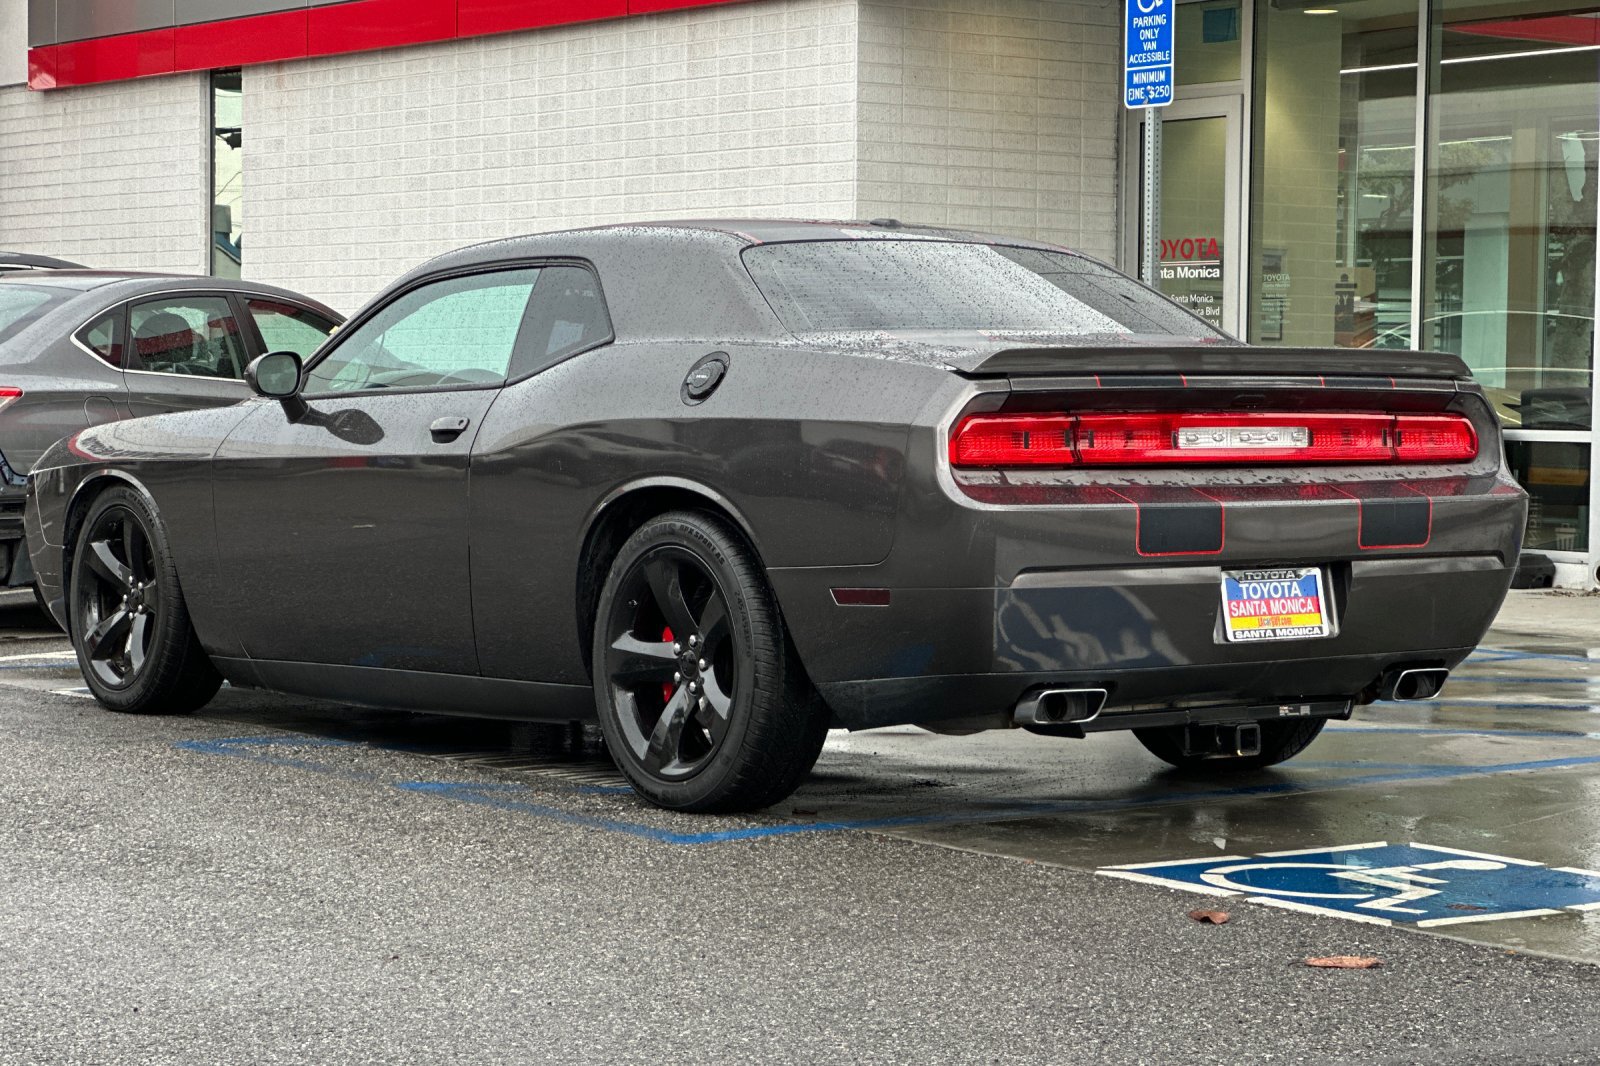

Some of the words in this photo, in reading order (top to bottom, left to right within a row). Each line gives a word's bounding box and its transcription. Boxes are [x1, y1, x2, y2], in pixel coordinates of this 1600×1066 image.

[1133, 14, 1167, 28] PARKING
[1140, 28, 1160, 40] ONLY
[1143, 41, 1156, 51] VAN
[1129, 51, 1170, 64] ACCESSIBLE
[1133, 70, 1166, 84] MINIMUM
[1128, 88, 1145, 101] FINE
[1148, 85, 1170, 99] $250
[1160, 237, 1220, 260] YOTA
[1177, 266, 1220, 279] Monica
[1190, 294, 1214, 303] Monica
[1205, 306, 1220, 316] Blvd
[1245, 571, 1295, 580] TOYOTA
[1238, 581, 1302, 600] TOYOTA
[1230, 600, 1268, 617] SANTA
[1270, 598, 1315, 615] MONICA
[1235, 629, 1274, 639] SANTA
[1275, 626, 1321, 637] MONICA
